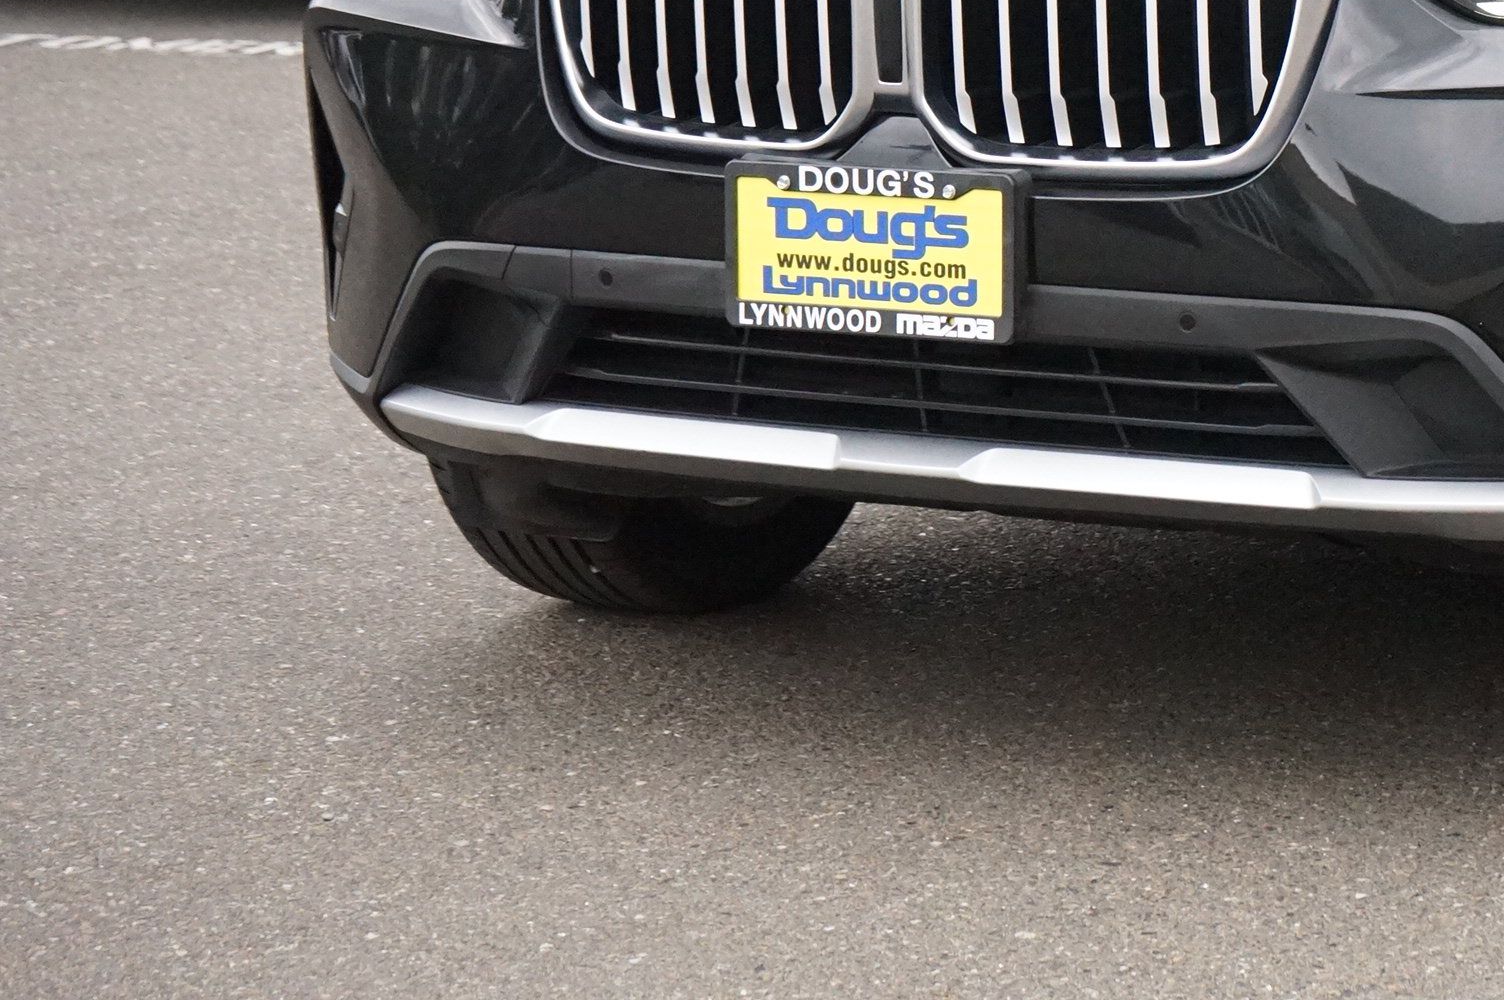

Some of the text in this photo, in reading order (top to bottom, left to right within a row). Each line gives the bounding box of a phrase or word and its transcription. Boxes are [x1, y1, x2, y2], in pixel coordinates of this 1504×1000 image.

[798, 165, 936, 199] DOUG'S
[777, 252, 967, 279] www.dougs.com
[762, 265, 978, 308] Lynnwood
[738, 302, 882, 334] LYNNWOOD
